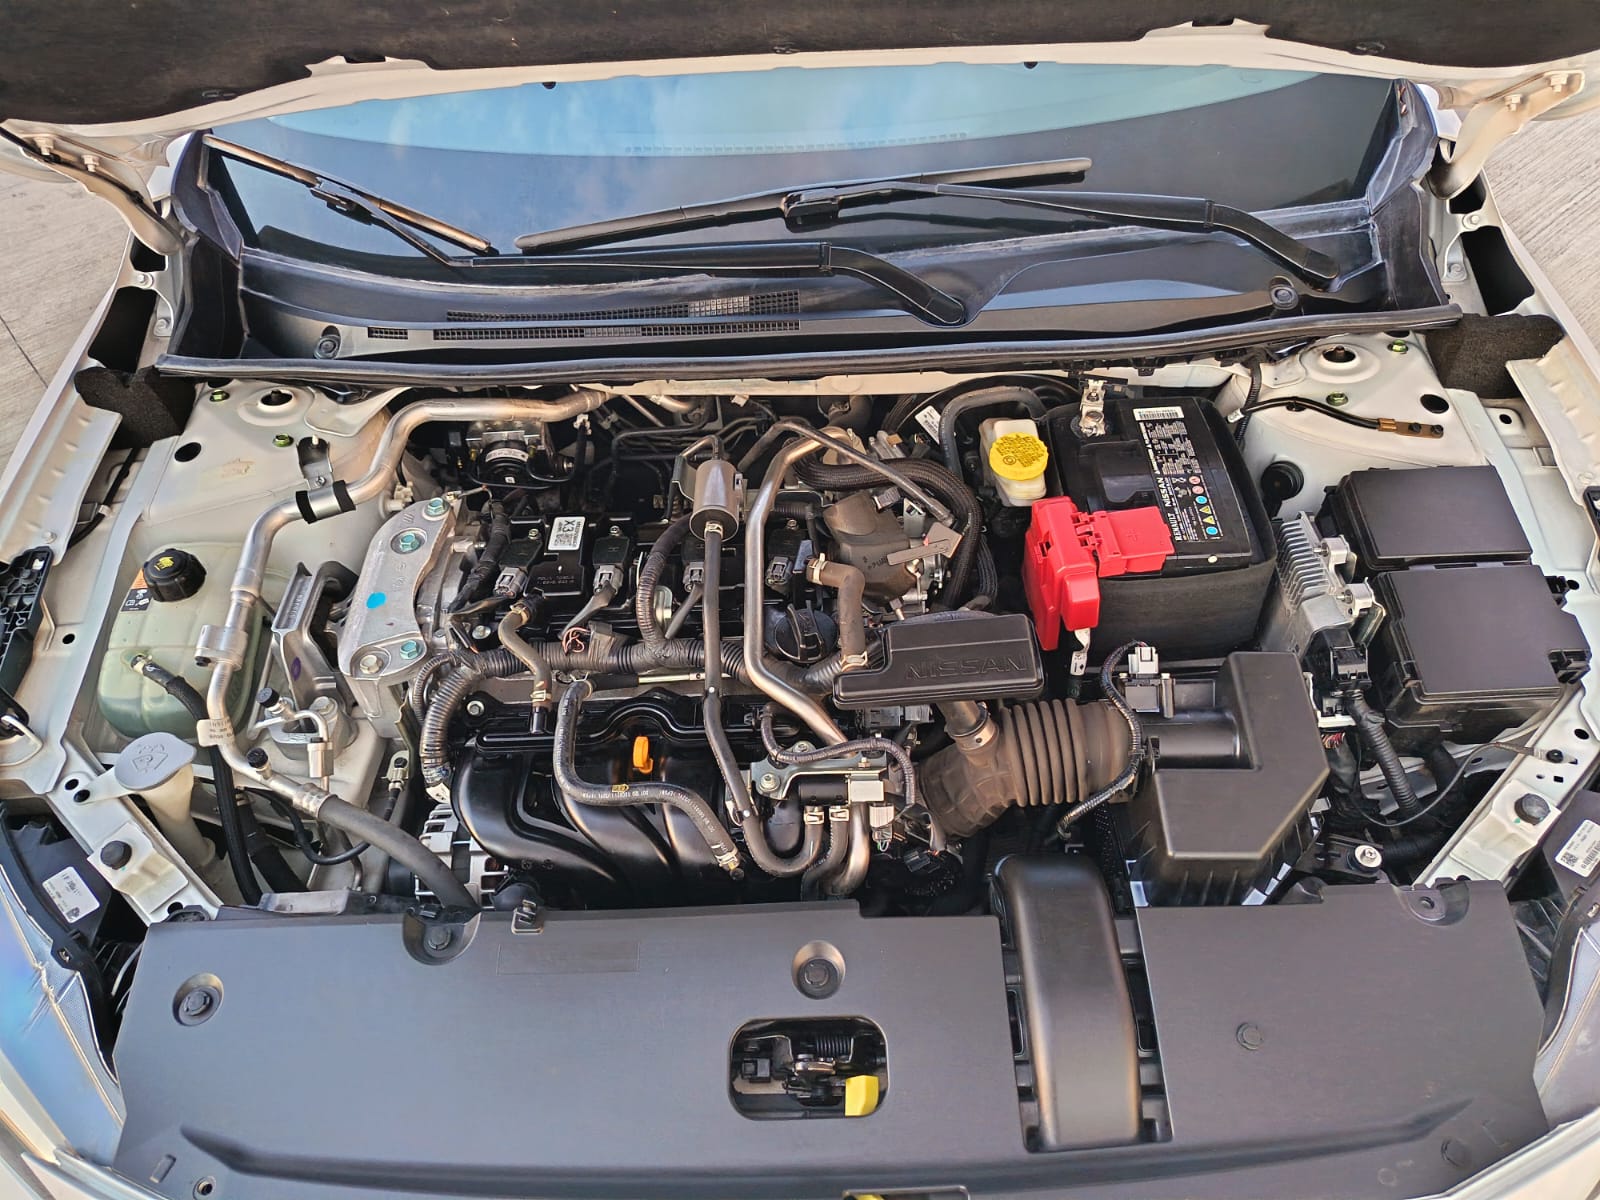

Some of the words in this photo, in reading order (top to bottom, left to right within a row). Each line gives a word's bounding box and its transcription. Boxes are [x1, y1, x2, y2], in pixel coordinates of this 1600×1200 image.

[1156, 477, 1172, 507] NISSAN
[562, 519, 576, 533] X3
[1167, 512, 1183, 541] RENAULT
[906, 654, 1028, 680] NISSAN
